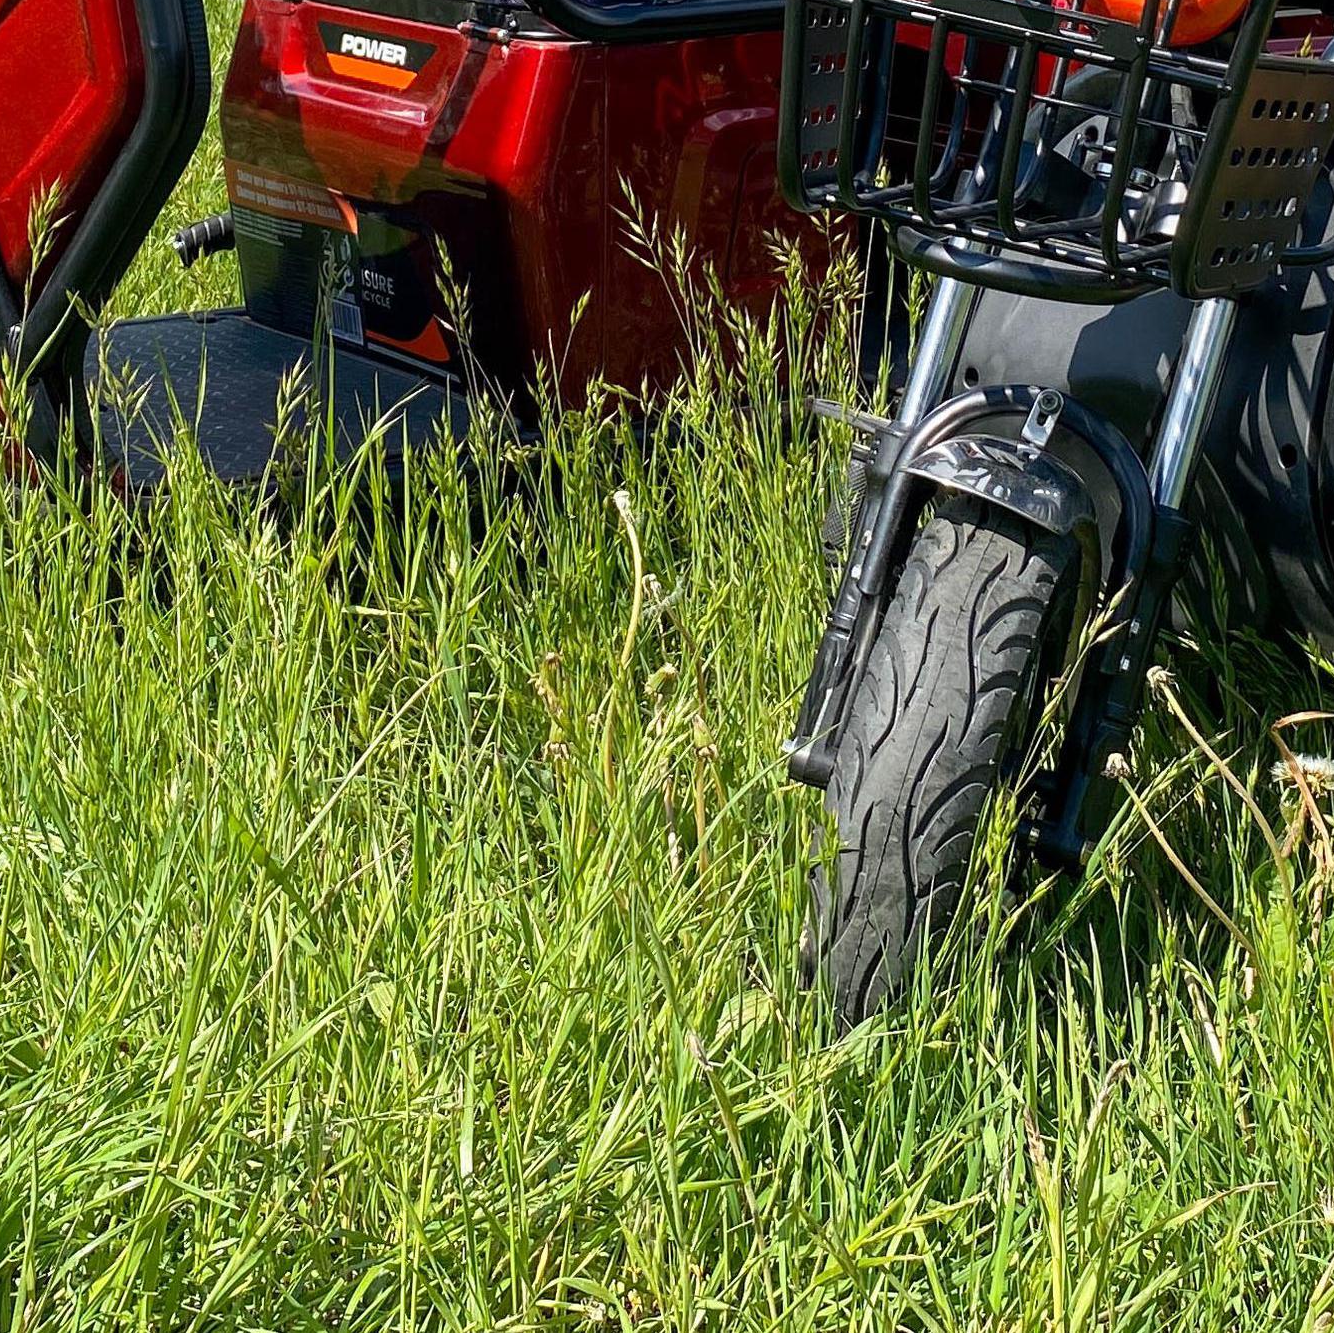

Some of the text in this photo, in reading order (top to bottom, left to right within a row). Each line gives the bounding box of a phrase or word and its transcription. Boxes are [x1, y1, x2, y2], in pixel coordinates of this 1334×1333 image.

[341, 33, 407, 66] POWER
[361, 268, 396, 295] ISURE
[363, 290, 392, 310] CYCLE
